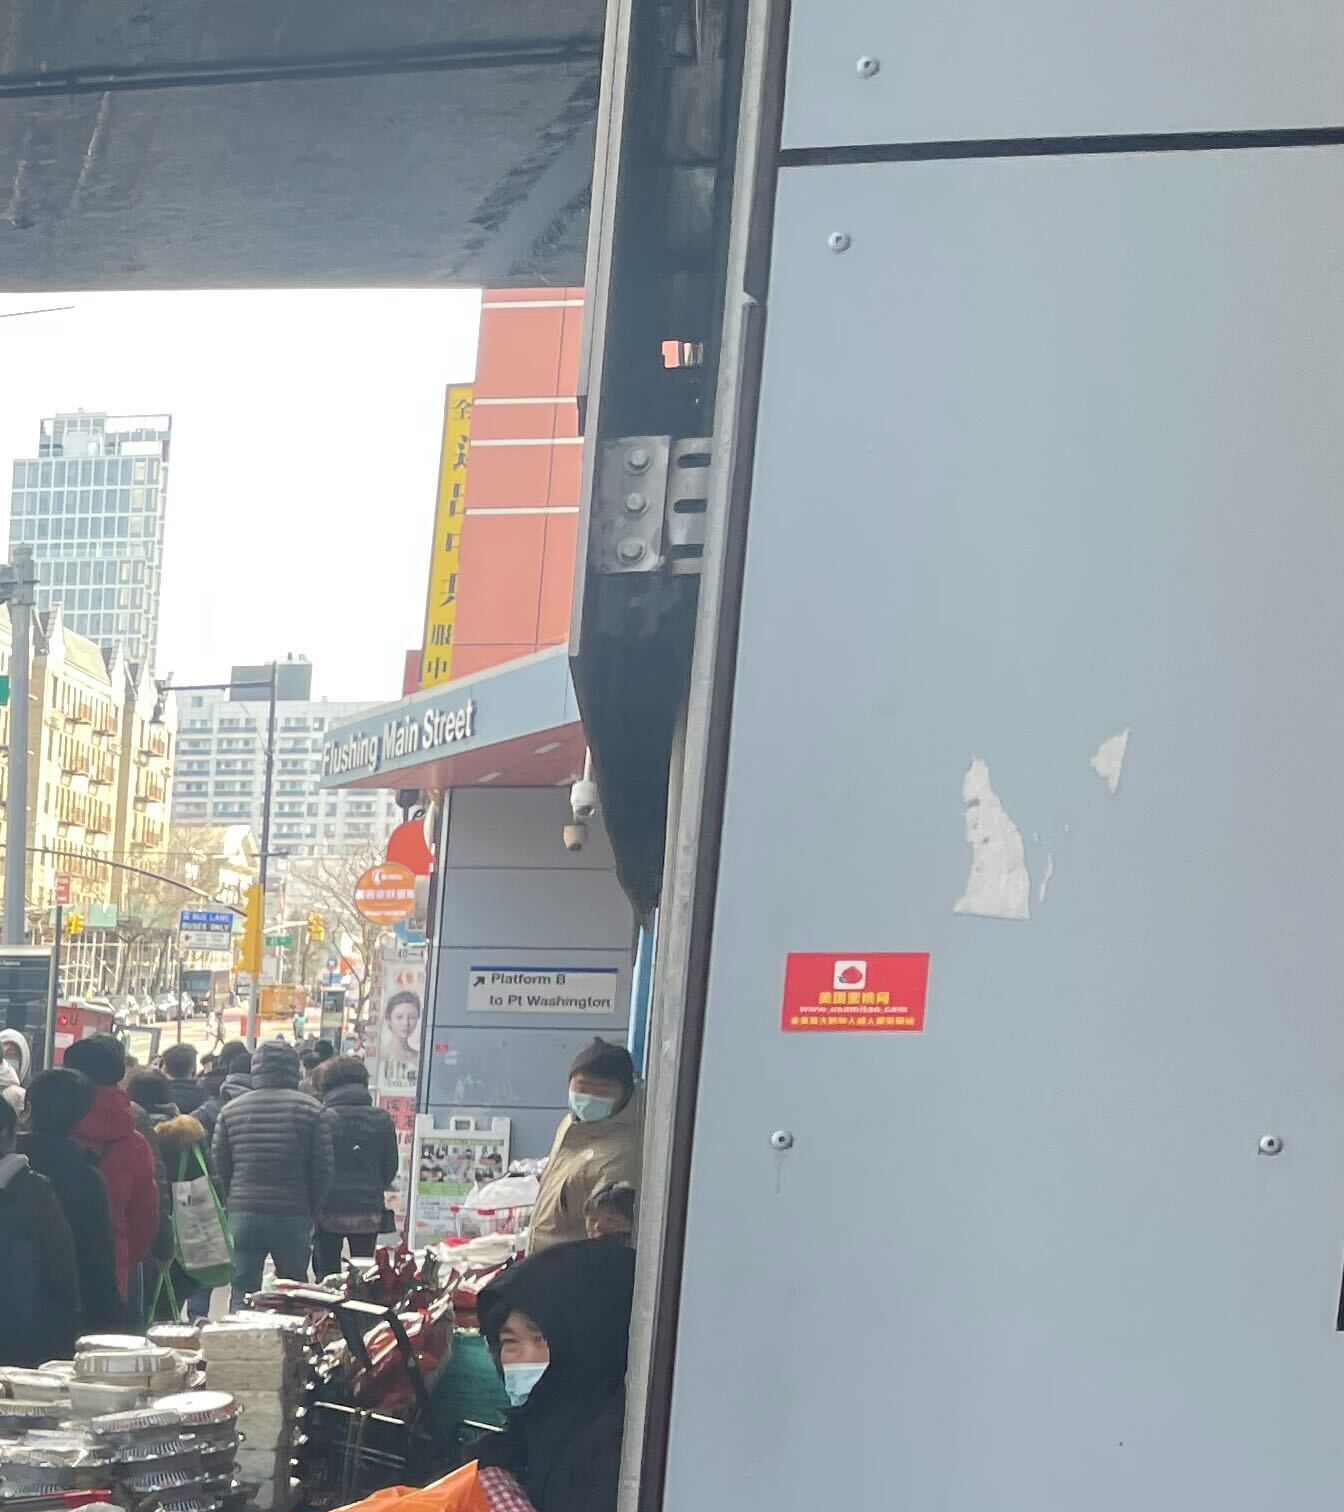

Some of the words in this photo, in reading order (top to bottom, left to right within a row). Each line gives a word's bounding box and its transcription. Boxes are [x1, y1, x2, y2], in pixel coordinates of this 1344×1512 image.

[322, 733, 378, 776] Flushing
[383, 716, 419, 760] Main
[422, 698, 475, 750] Street
[491, 973, 551, 985] Platform
[556, 974, 566, 985] B
[490, 995, 503, 1006] to
[508, 995, 523, 1006] Pt
[527, 995, 611, 1009] Washington
